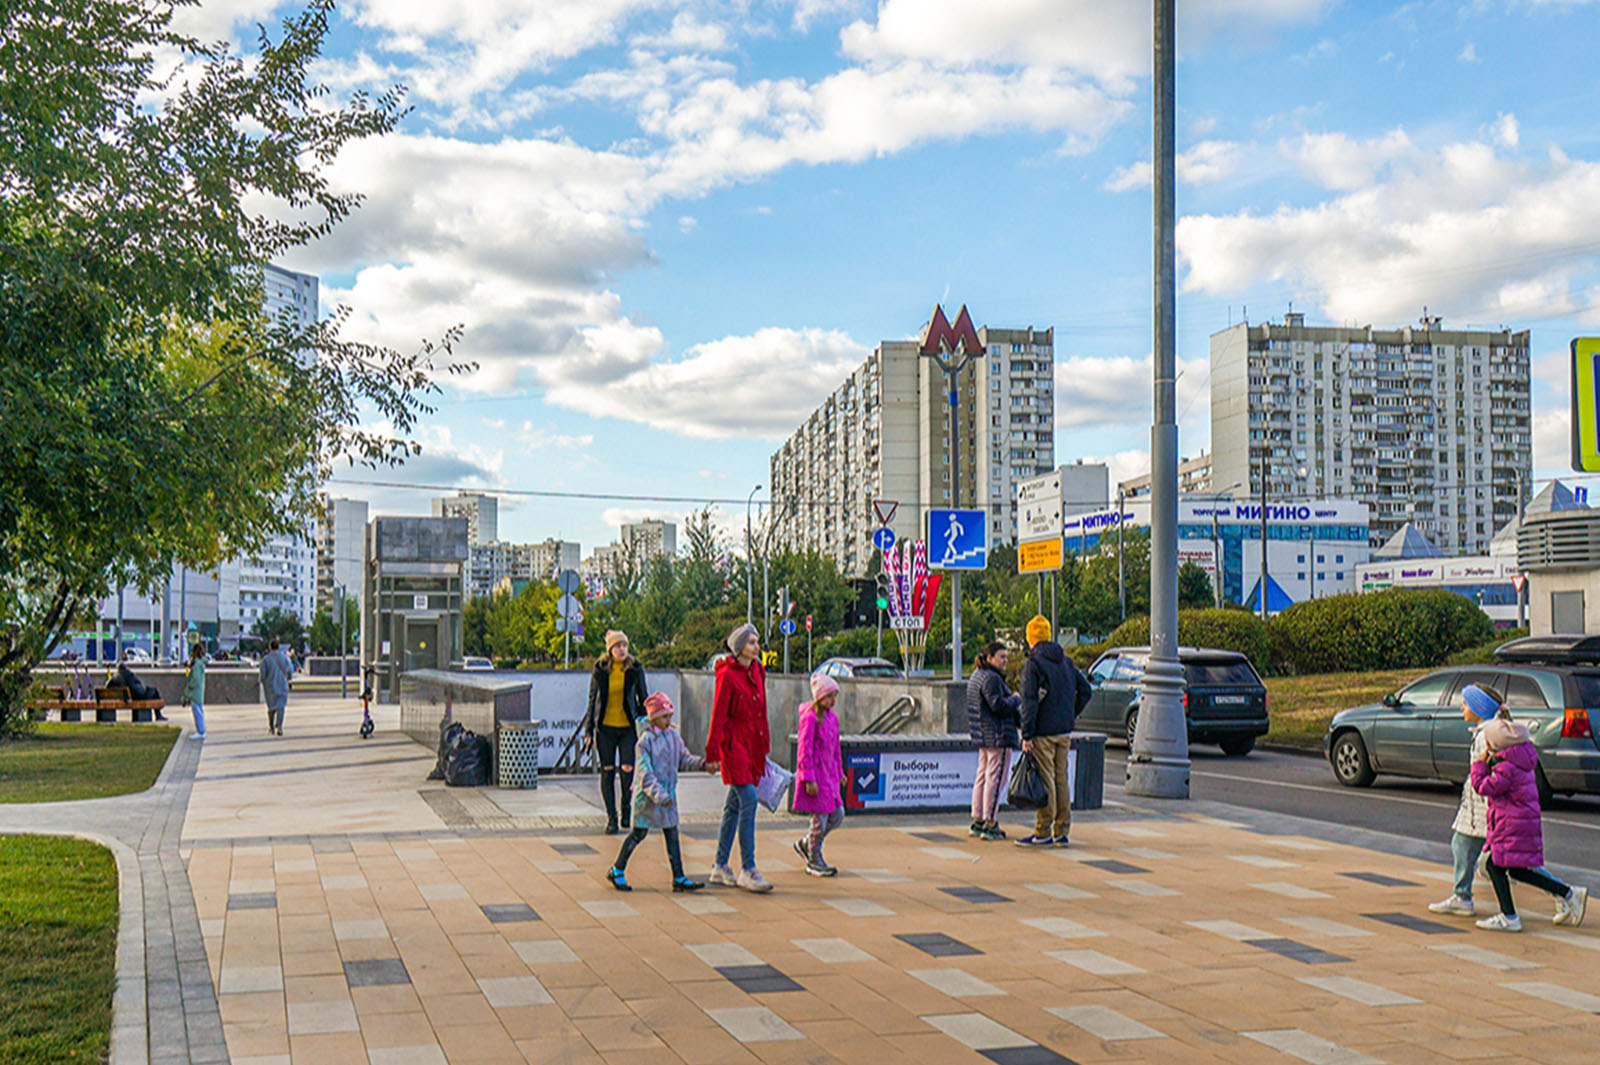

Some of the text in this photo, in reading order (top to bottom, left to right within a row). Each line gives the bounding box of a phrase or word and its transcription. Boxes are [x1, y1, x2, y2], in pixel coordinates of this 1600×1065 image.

[1236, 505, 1311, 520] МИТИНО
[1314, 509, 1338, 518] ЦЕНТР
[1082, 511, 1120, 528] МИТИНО
[895, 618, 920, 627] СТОП
[894, 759, 939, 772] Выборы
[892, 772, 961, 782] депутатов советов
[892, 782, 929, 791] депутатов
[892, 792, 941, 801] образований
